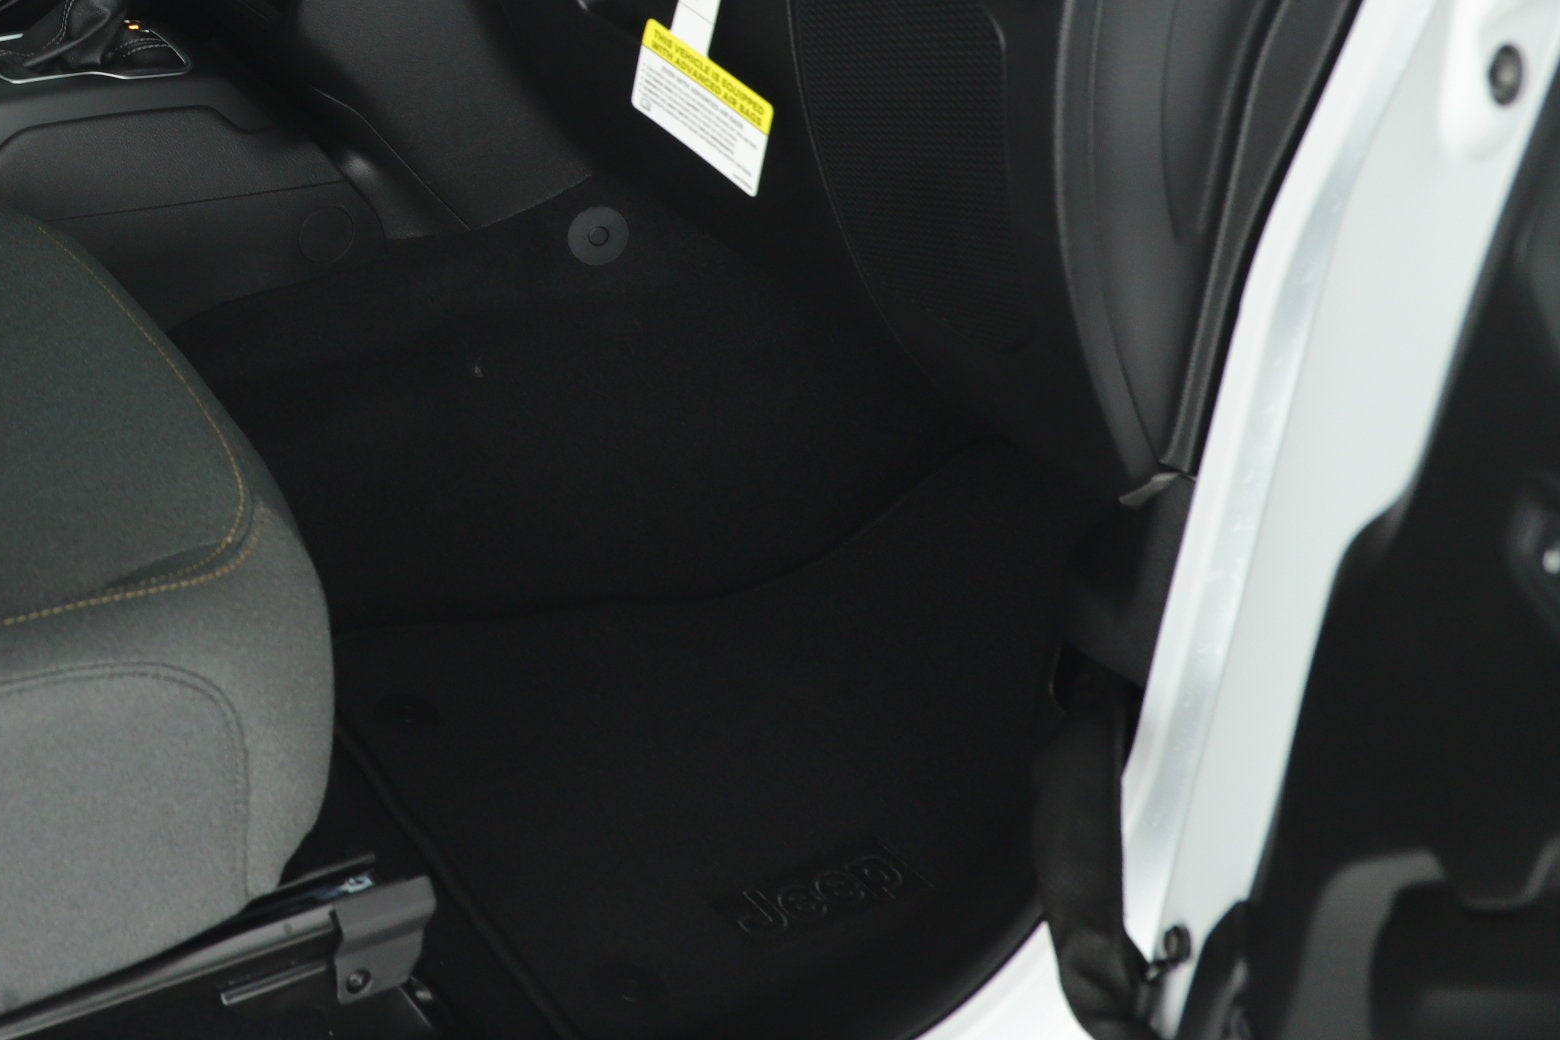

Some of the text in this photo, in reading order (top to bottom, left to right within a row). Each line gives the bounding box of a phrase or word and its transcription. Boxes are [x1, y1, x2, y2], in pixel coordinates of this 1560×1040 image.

[651, 39, 762, 127] WITH ADVANCED AIR BAGS
[653, 28, 765, 116] THIS VEHICLE IS EQUIPPED
[736, 856, 903, 936] Jeep
